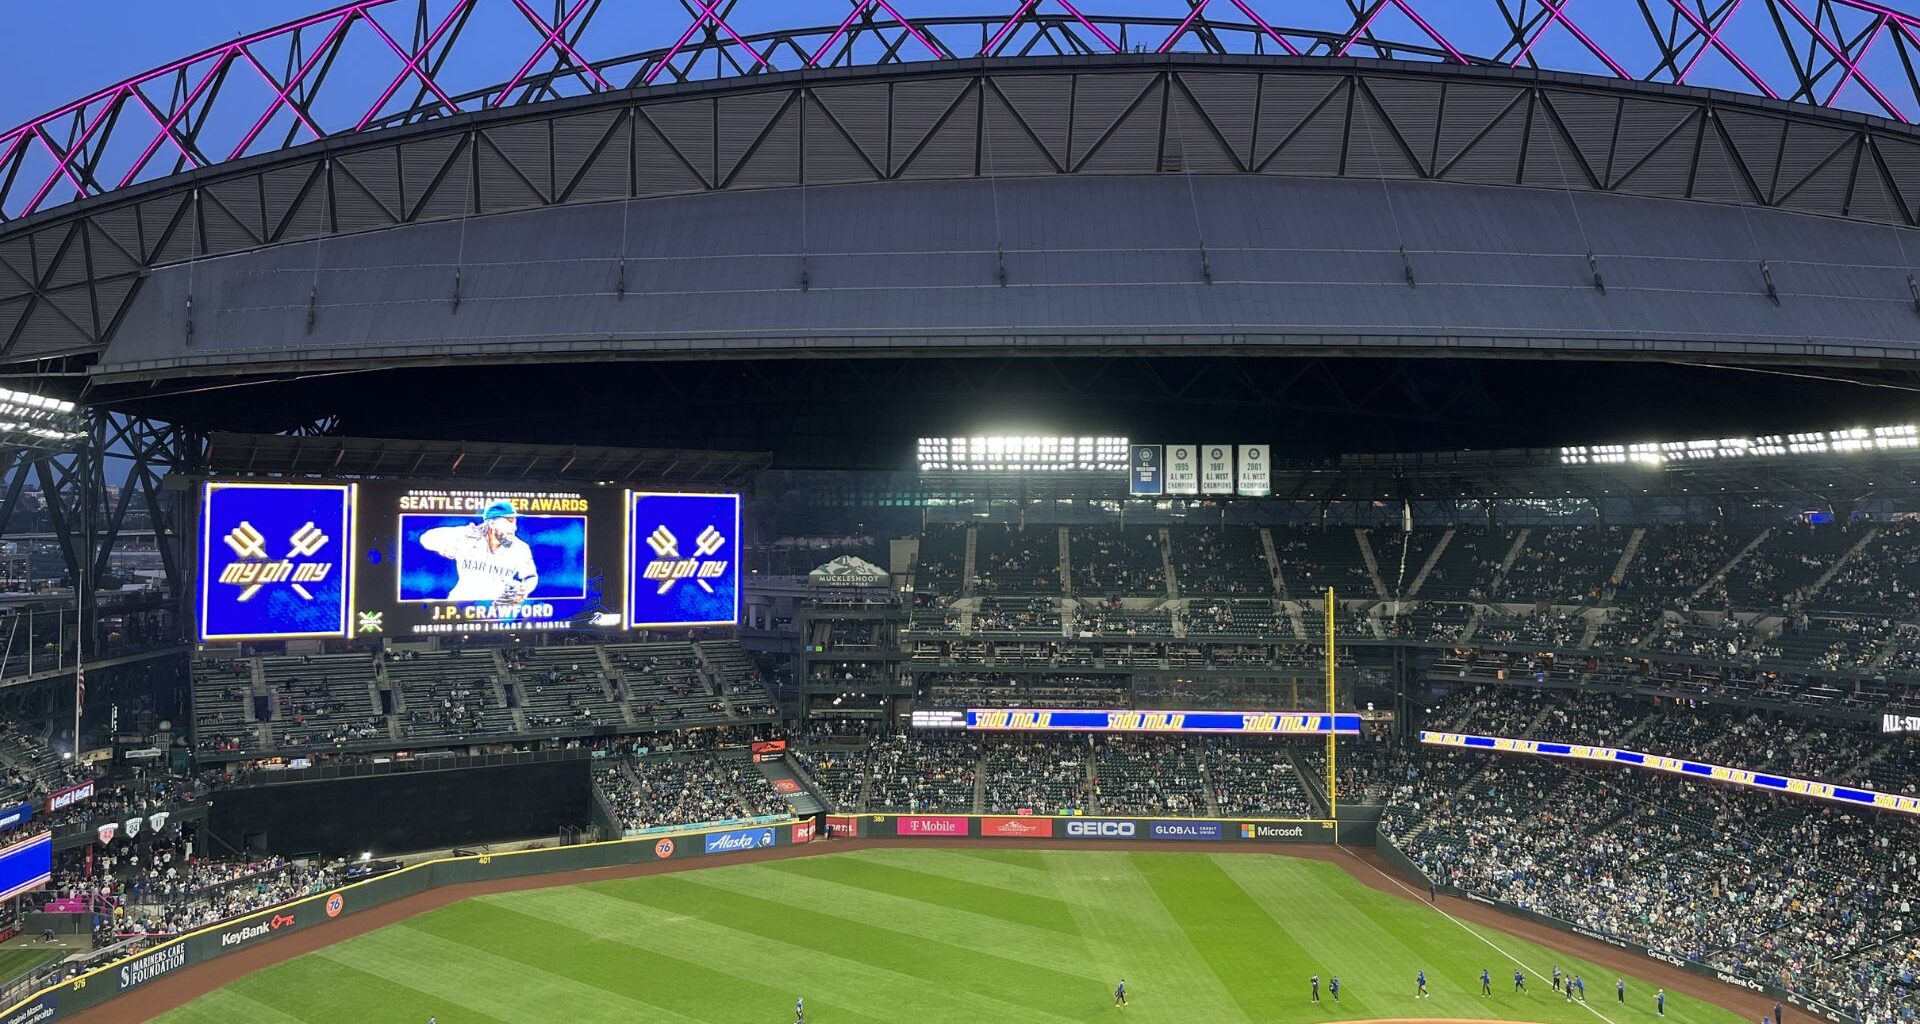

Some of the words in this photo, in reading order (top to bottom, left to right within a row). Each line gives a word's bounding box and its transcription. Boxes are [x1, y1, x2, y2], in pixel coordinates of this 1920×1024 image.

[400, 496, 463, 510] SEATTLE
[531, 498, 588, 511] AWARDS
[432, 606, 460, 620] J.P.
[465, 604, 553, 619] CRAWFORD
[413, 624, 452, 632] UNSUNG
[456, 623, 481, 631] HERO
[492, 622, 522, 630] HEART
[536, 620, 571, 629] HUSTLE
[130, 824, 138, 833] 24
[922, 820, 956, 831] Mobile
[1067, 821, 1135, 836] GEICO
[1156, 826, 1197, 834] GLOBAL
[1258, 826, 1302, 836] Microsoft
[659, 842, 670, 852] 76
[709, 834, 752, 850] Alaska
[479, 856, 491, 864] 401
[329, 900, 340, 911] 76
[222, 922, 270, 946] KeyBank
[133, 950, 166, 972] MARINERS
[168, 943, 185, 957] CARE
[1648, 949, 1667, 961] Great
[1668, 956, 1685, 967] Clips
[132, 952, 185, 985] FOUNDATION
[74, 981, 86, 990] 376
[1717, 972, 1747, 987] KeyBank
[34, 1007, 54, 1021] Health
